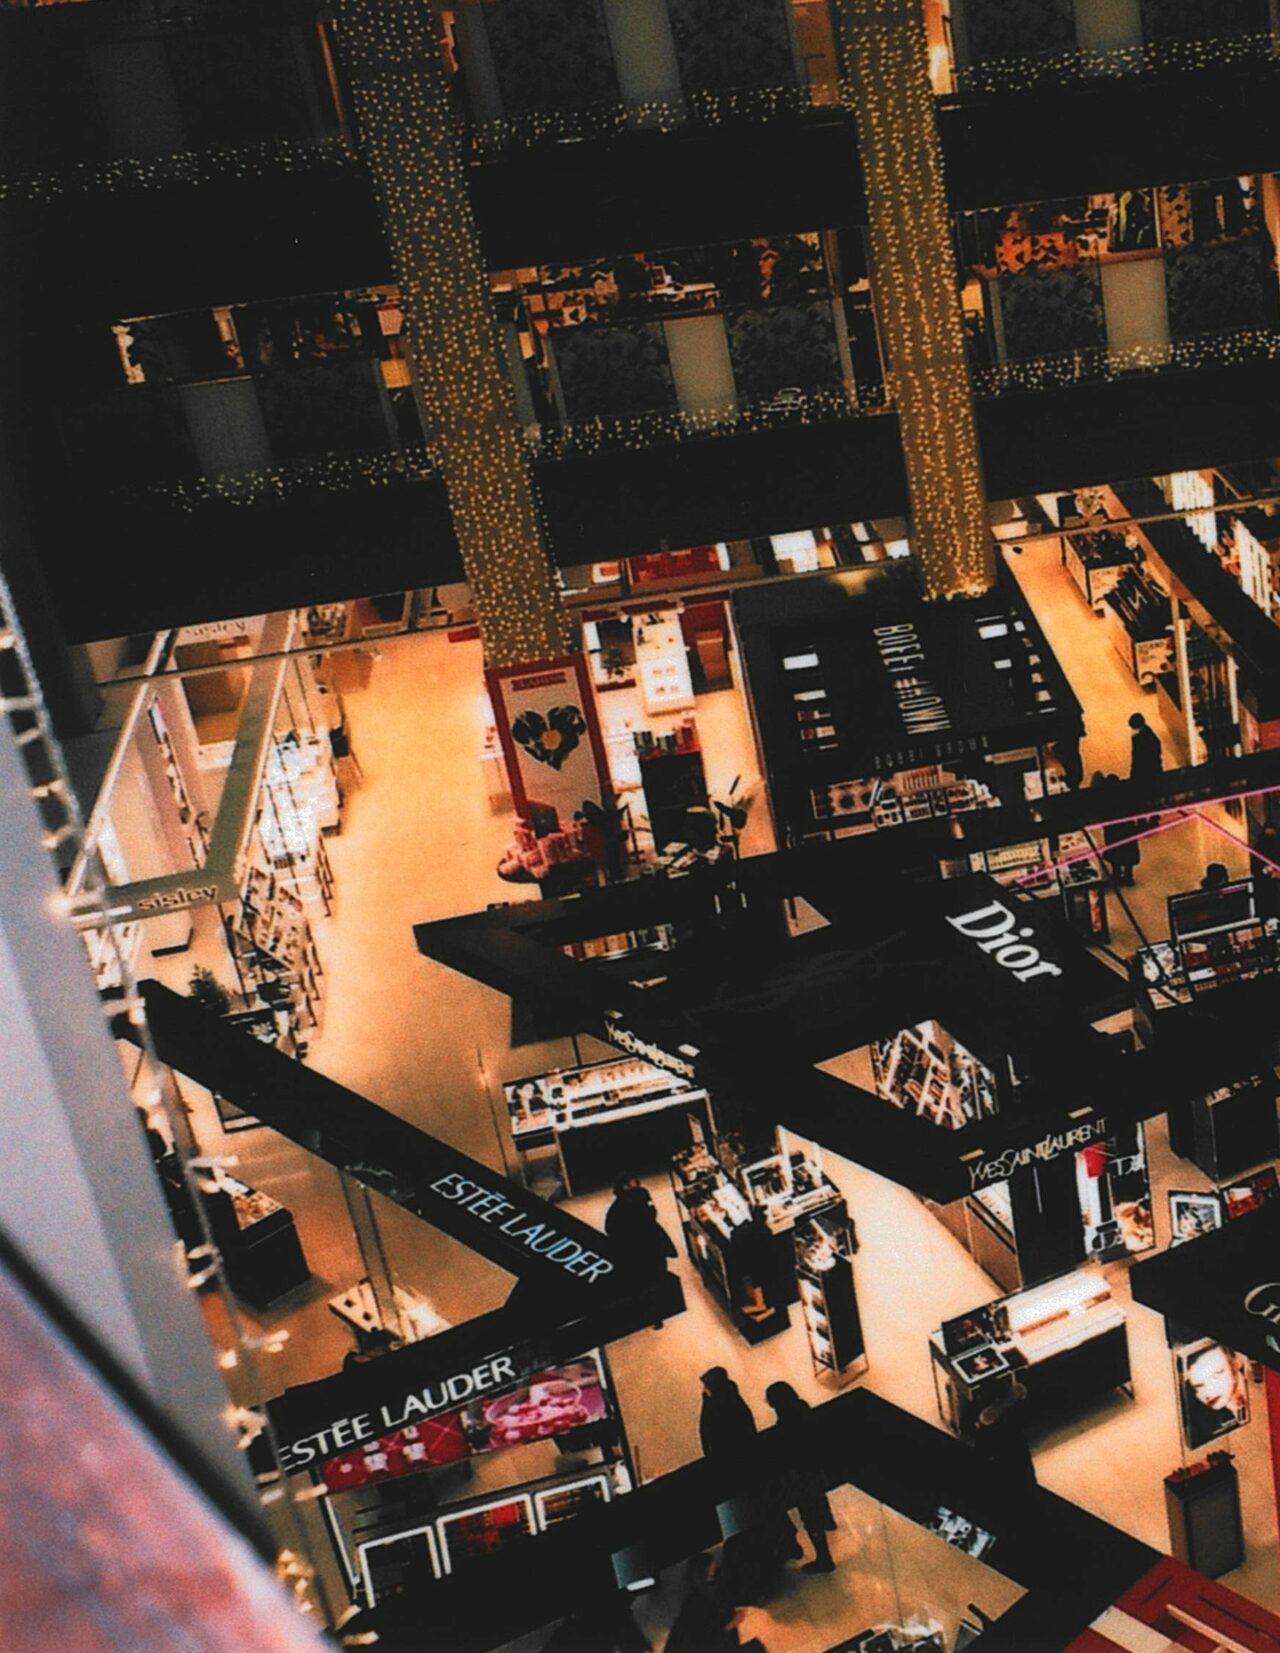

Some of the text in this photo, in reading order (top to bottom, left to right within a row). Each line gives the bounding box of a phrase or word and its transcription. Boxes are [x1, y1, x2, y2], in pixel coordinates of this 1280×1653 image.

[137, 884, 217, 912] sisley
[944, 899, 1063, 983] Dior
[499, 1212, 615, 1285] LAUDER
[380, 1355, 517, 1428] LAUDER
